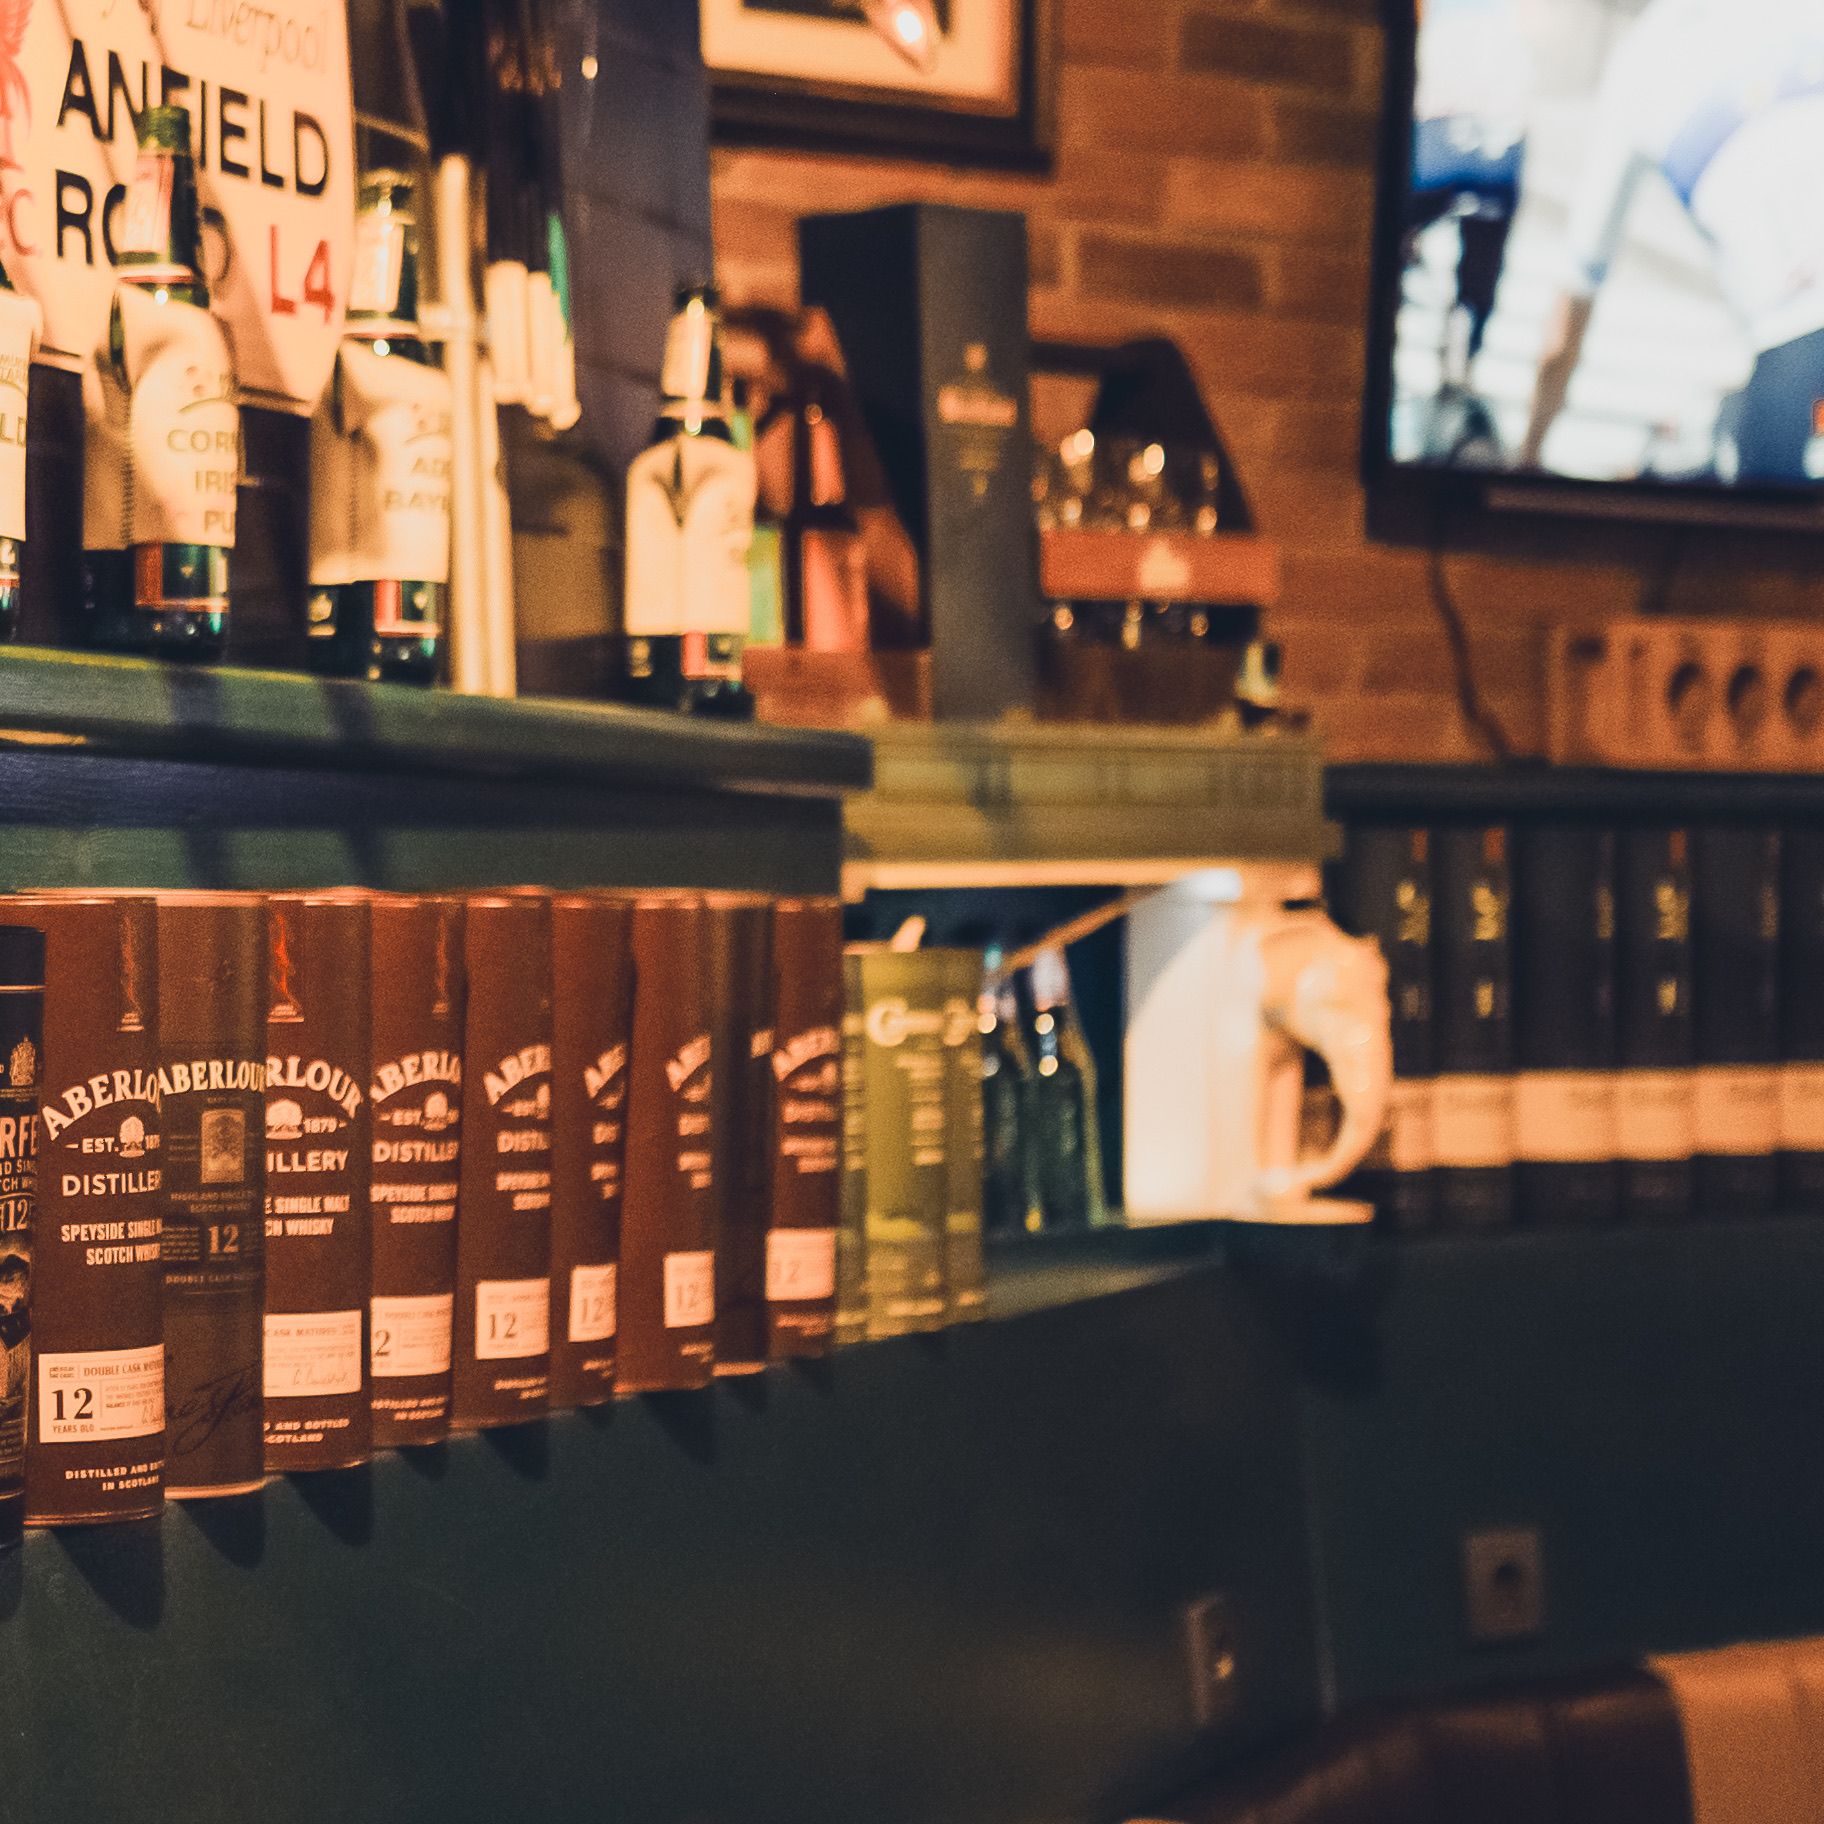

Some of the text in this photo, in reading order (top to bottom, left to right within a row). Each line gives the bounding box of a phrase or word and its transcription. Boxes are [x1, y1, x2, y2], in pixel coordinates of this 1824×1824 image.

[56, 37, 330, 197] ANFIELD
[271, 222, 336, 326] L4
[266, 1056, 363, 1120] RLOUR
[303, 1117, 338, 1134] 1879
[81, 1136, 120, 1154] EST.
[265, 1149, 350, 1174] ILLERY
[6, 1198, 29, 1232] 12
[274, 1196, 323, 1215] SINGLE
[60, 1221, 126, 1243] SPEYSIDE
[285, 1218, 335, 1237] WHISKY
[208, 1223, 241, 1254] 12
[85, 1245, 134, 1266] SCOTCH
[488, 1312, 517, 1340] 12
[83, 1367, 120, 1377] DOUBLE
[51, 1387, 94, 1422] 12
[52, 1423, 95, 1435] YEARS OLD
[65, 1466, 128, 1481] DISTILLED
[101, 1482, 116, 1492] IN
